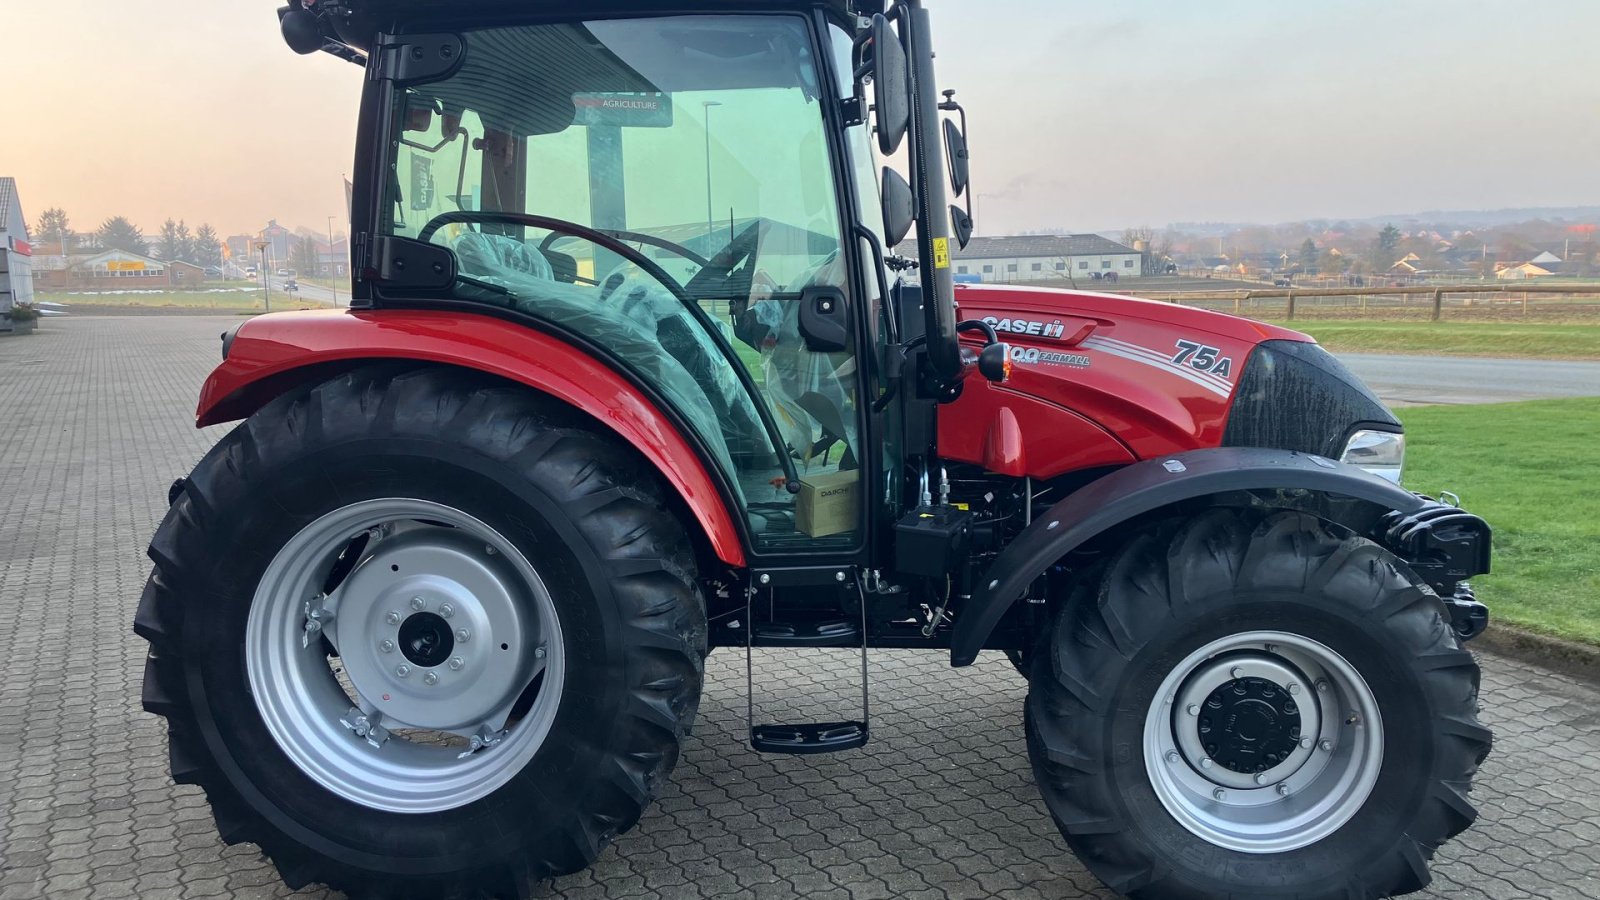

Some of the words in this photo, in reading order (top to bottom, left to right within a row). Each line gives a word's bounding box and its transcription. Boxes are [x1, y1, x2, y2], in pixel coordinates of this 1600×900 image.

[602, 99, 657, 110] AGRICULTURE
[981, 316, 1043, 335] CASE
[1007, 345, 1040, 361] 00
[1039, 351, 1090, 366] FARMALL
[1170, 338, 1232, 378] 75A
